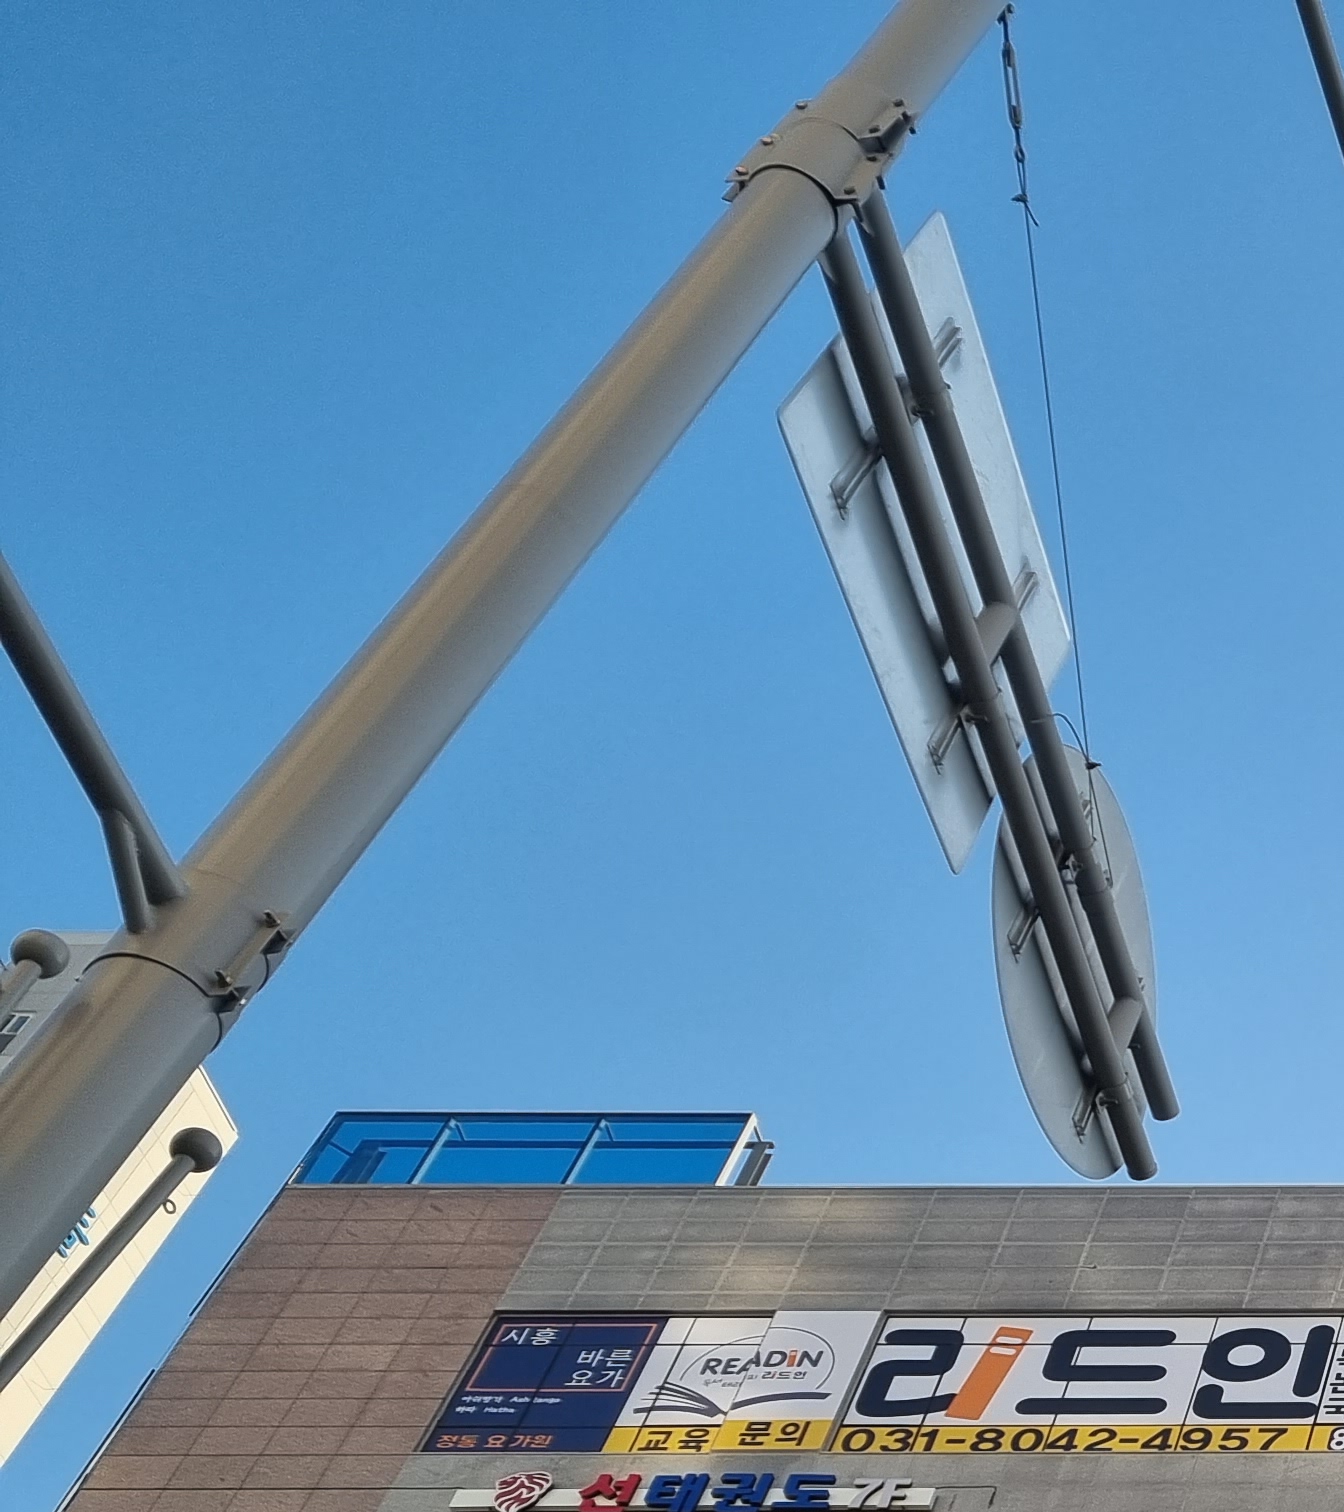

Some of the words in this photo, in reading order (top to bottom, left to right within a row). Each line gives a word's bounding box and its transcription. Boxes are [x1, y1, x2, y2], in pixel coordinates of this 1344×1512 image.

[501, 1327, 560, 1346] 시흥
[576, 1348, 633, 1368] 바른
[564, 1369, 625, 1388] 요가
[636, 1428, 711, 1452] 교육
[737, 1421, 813, 1447] 문의
[840, 1426, 1289, 1453] 031-8042-4957
[841, 1476, 913, 1510] 7F
